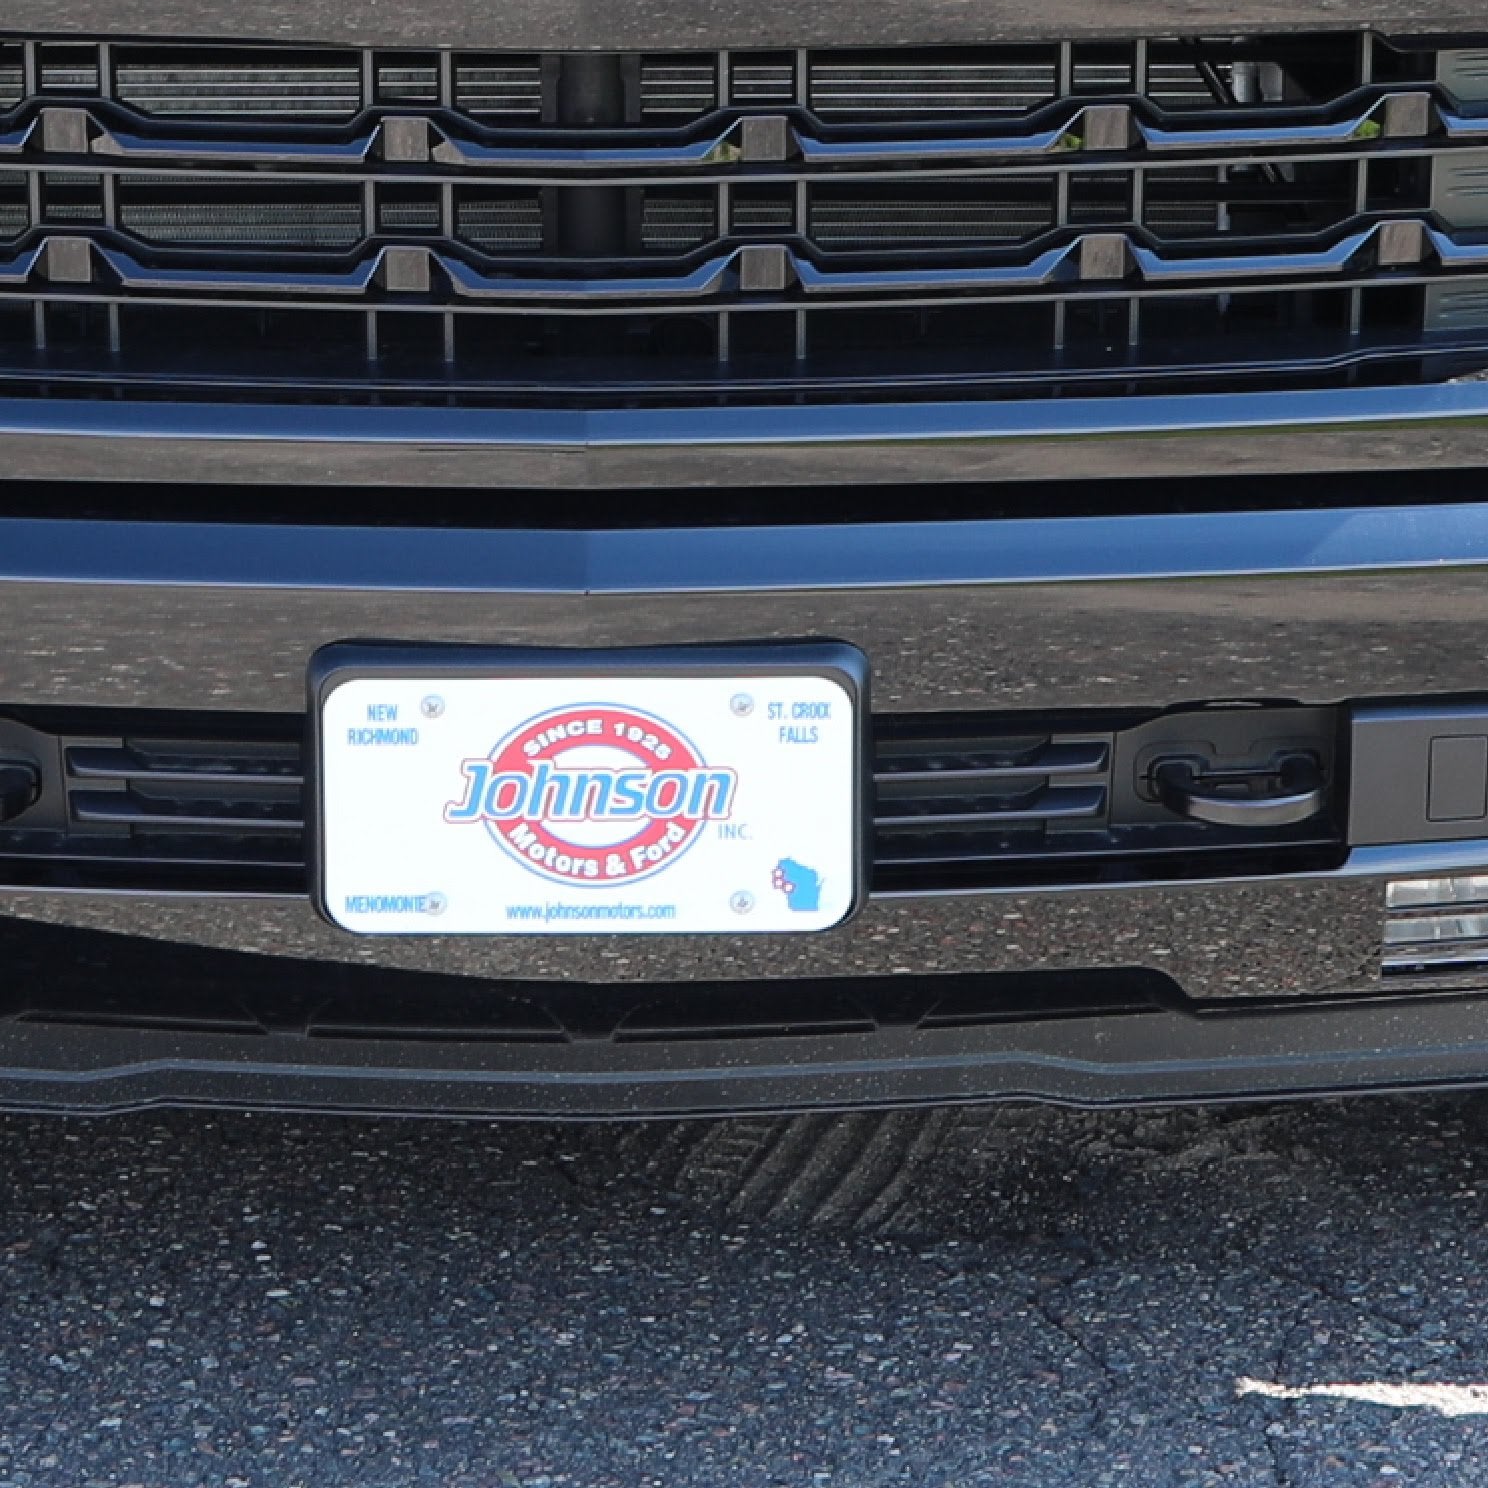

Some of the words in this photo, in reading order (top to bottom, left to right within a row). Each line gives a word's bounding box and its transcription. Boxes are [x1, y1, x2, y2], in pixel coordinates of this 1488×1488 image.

[367, 704, 398, 720] NEW
[768, 702, 788, 720] ST.
[347, 728, 419, 745] RICHMOND
[523, 719, 604, 757] SINCE
[779, 726, 819, 744] FALLS
[448, 760, 734, 821] Johnson
[717, 824, 753, 840] INC.
[508, 822, 600, 877] Motors
[605, 853, 627, 876] &
[630, 822, 687, 870] Ford
[505, 902, 676, 923] www.johnsonmotors.com
